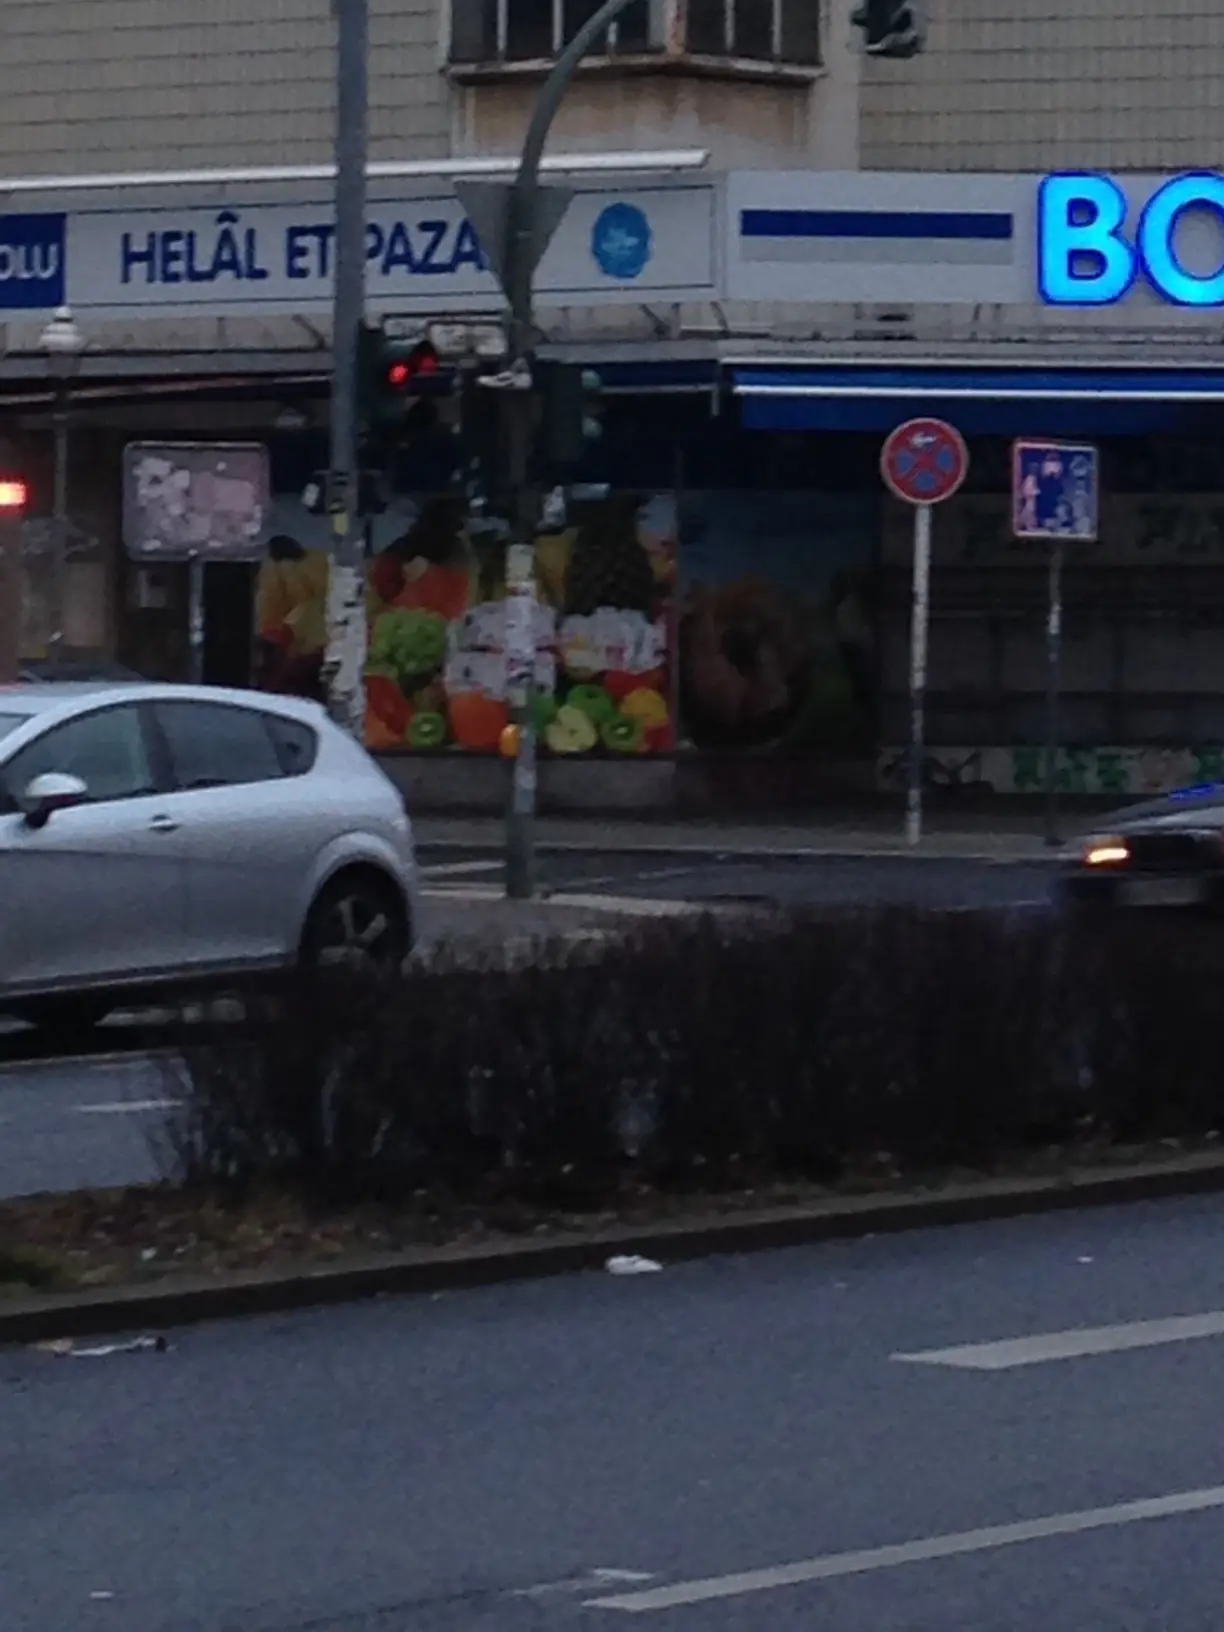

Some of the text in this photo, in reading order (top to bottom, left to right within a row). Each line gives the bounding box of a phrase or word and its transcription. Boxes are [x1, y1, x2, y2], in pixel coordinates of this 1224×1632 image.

[0, 243, 59, 282] OLU
[120, 210, 269, 284] HELÂL
[286, 225, 338, 279] ET
